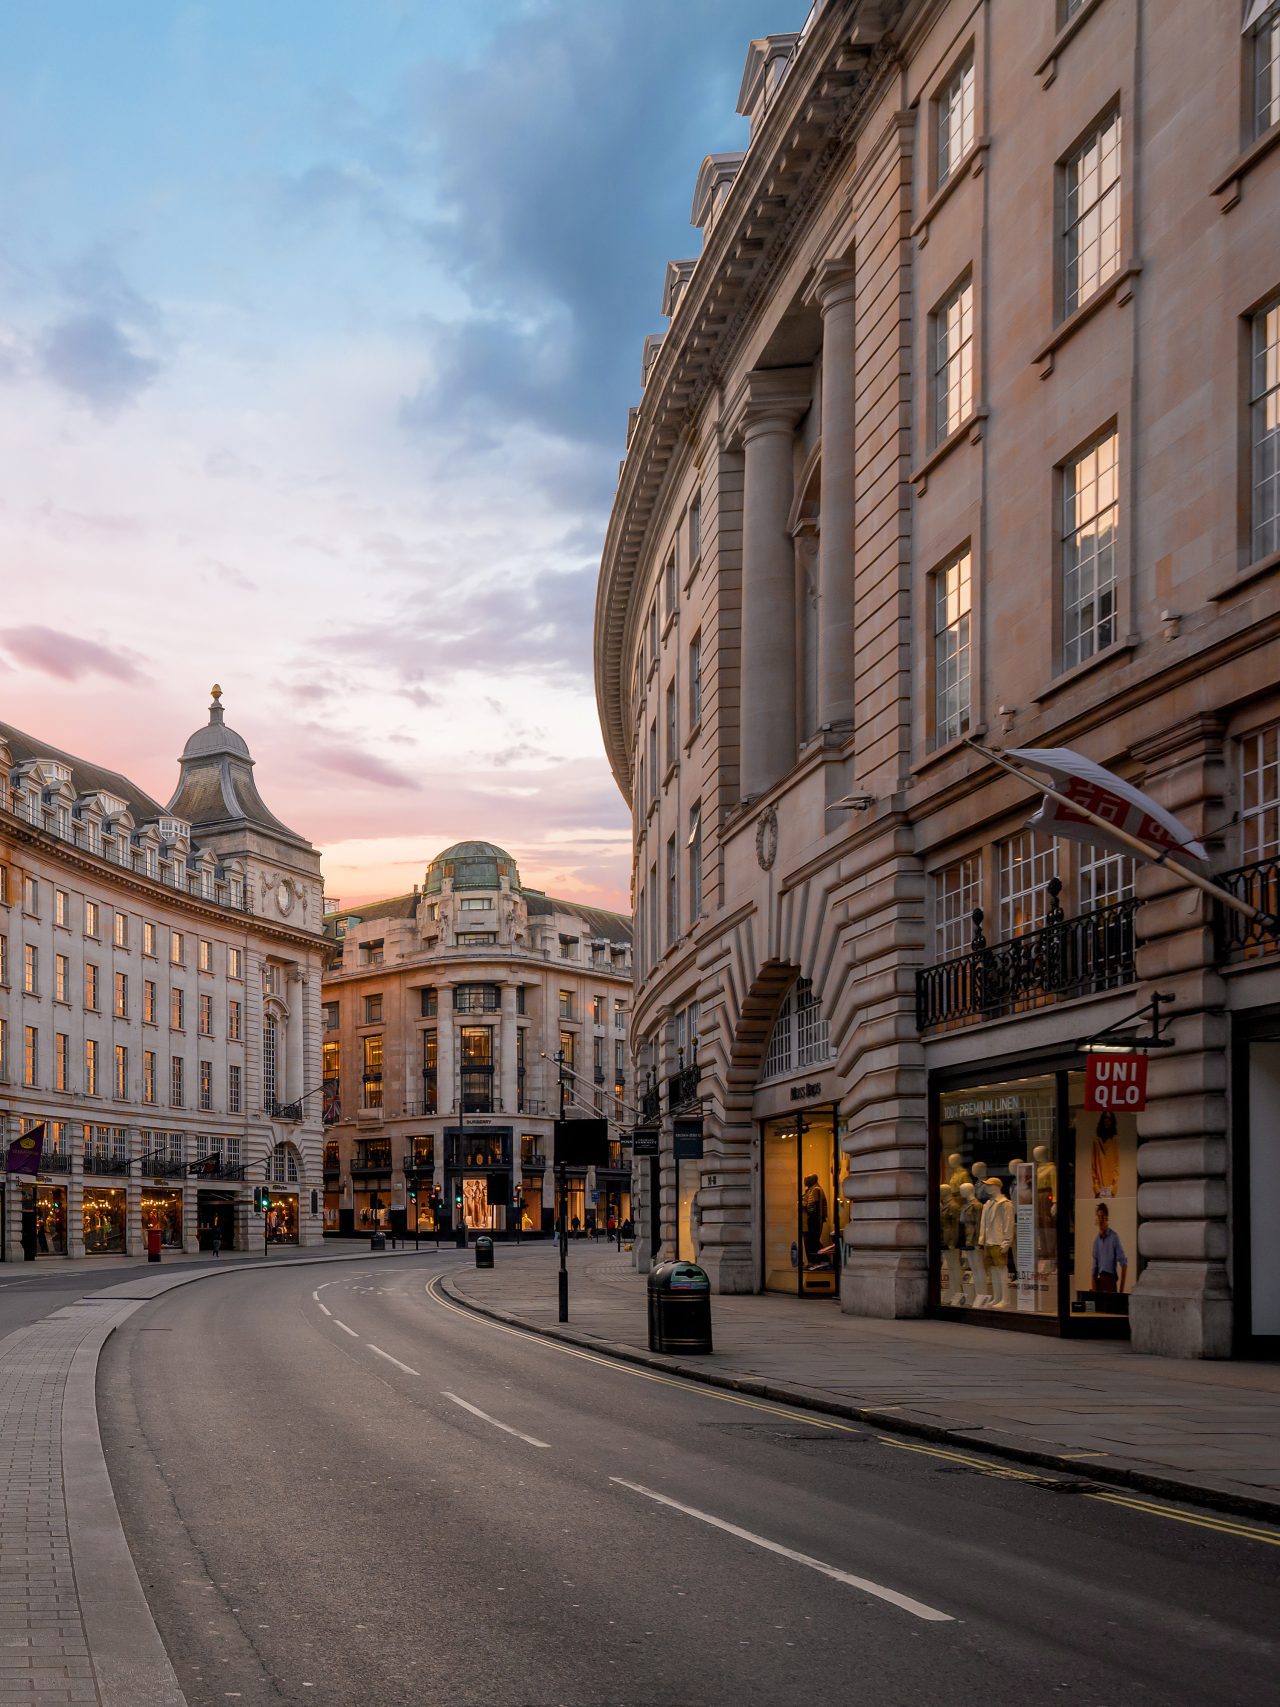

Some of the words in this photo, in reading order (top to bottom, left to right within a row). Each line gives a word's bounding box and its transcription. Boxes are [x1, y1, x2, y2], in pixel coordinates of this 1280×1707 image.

[1095, 1061, 1137, 1081] UNI
[944, 1104, 958, 1119] 100%
[960, 1099, 993, 1117] PREMIUM
[995, 1095, 1019, 1112] LINEN
[1094, 1085, 1140, 1108] QLO
